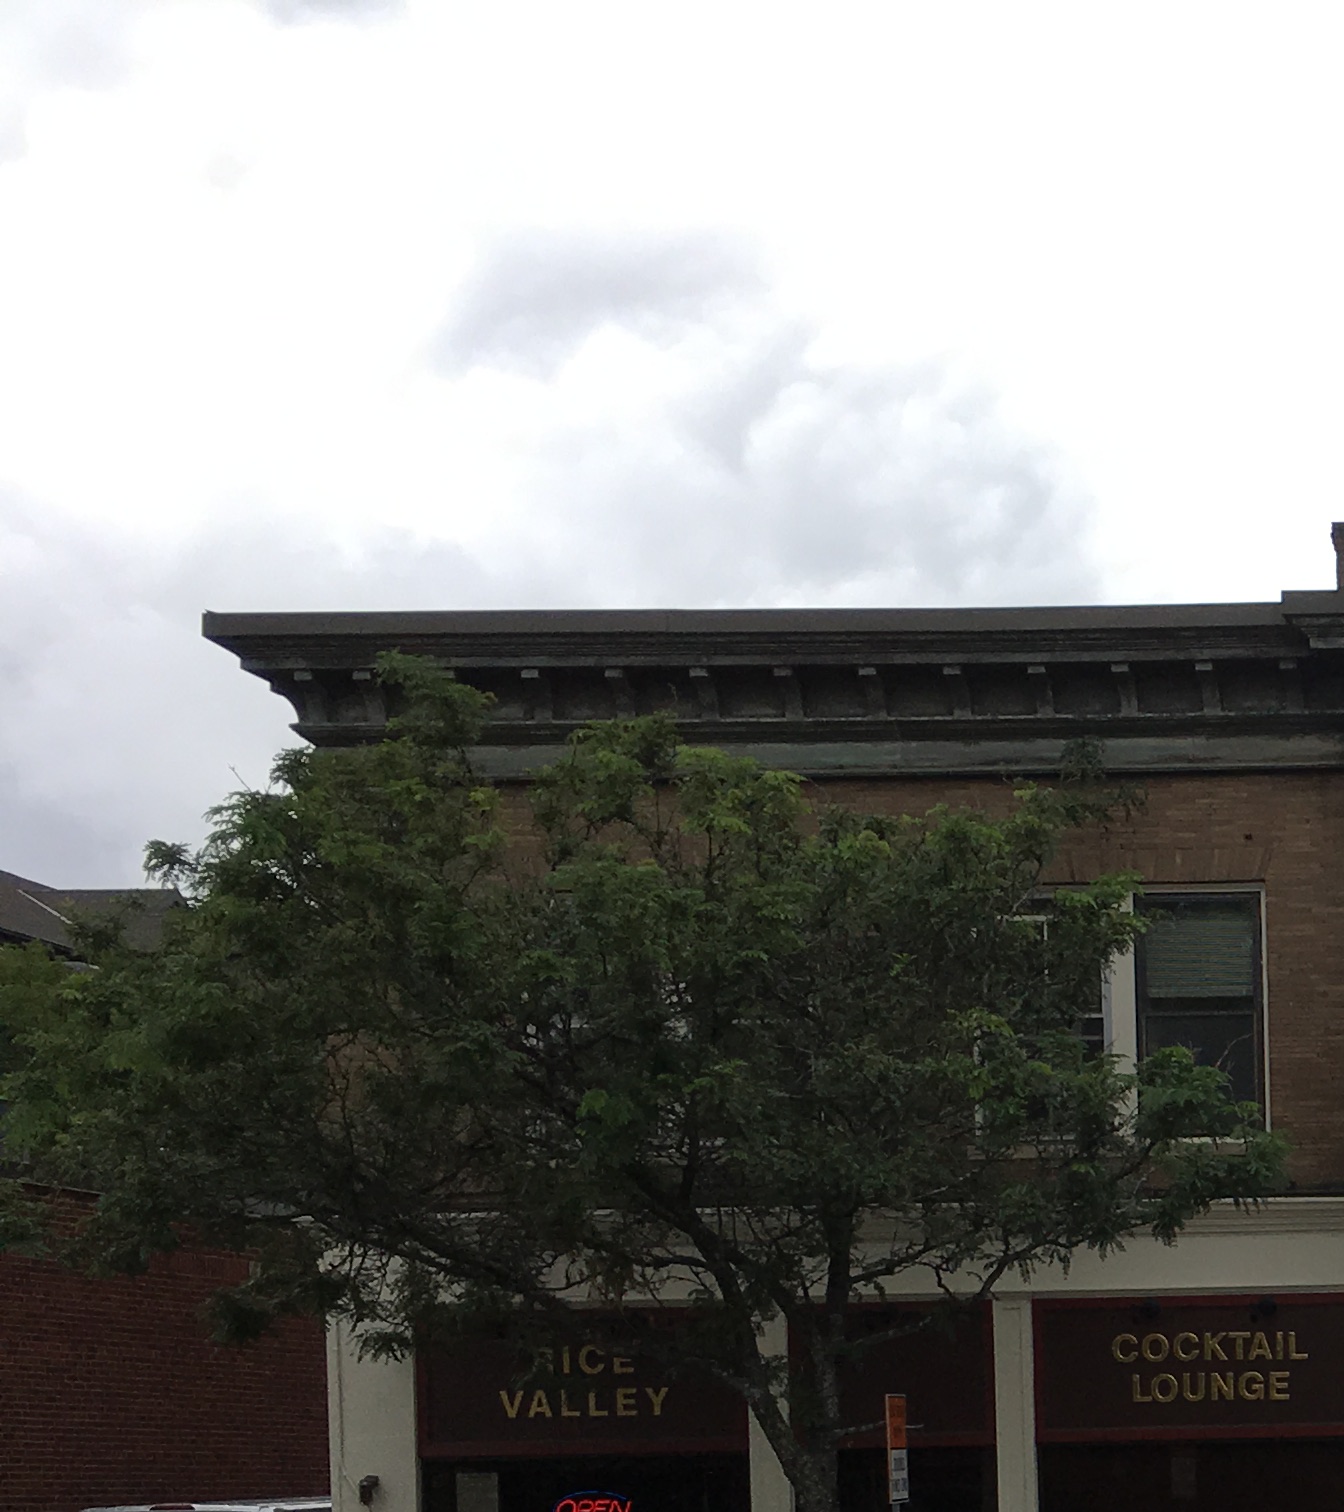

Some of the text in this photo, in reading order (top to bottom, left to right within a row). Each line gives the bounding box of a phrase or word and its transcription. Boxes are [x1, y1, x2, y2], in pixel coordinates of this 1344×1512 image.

[1111, 1331, 1309, 1363] COCKTAIL
[1132, 1370, 1290, 1403] LOUNGE
[499, 1387, 669, 1419] VALLEY
